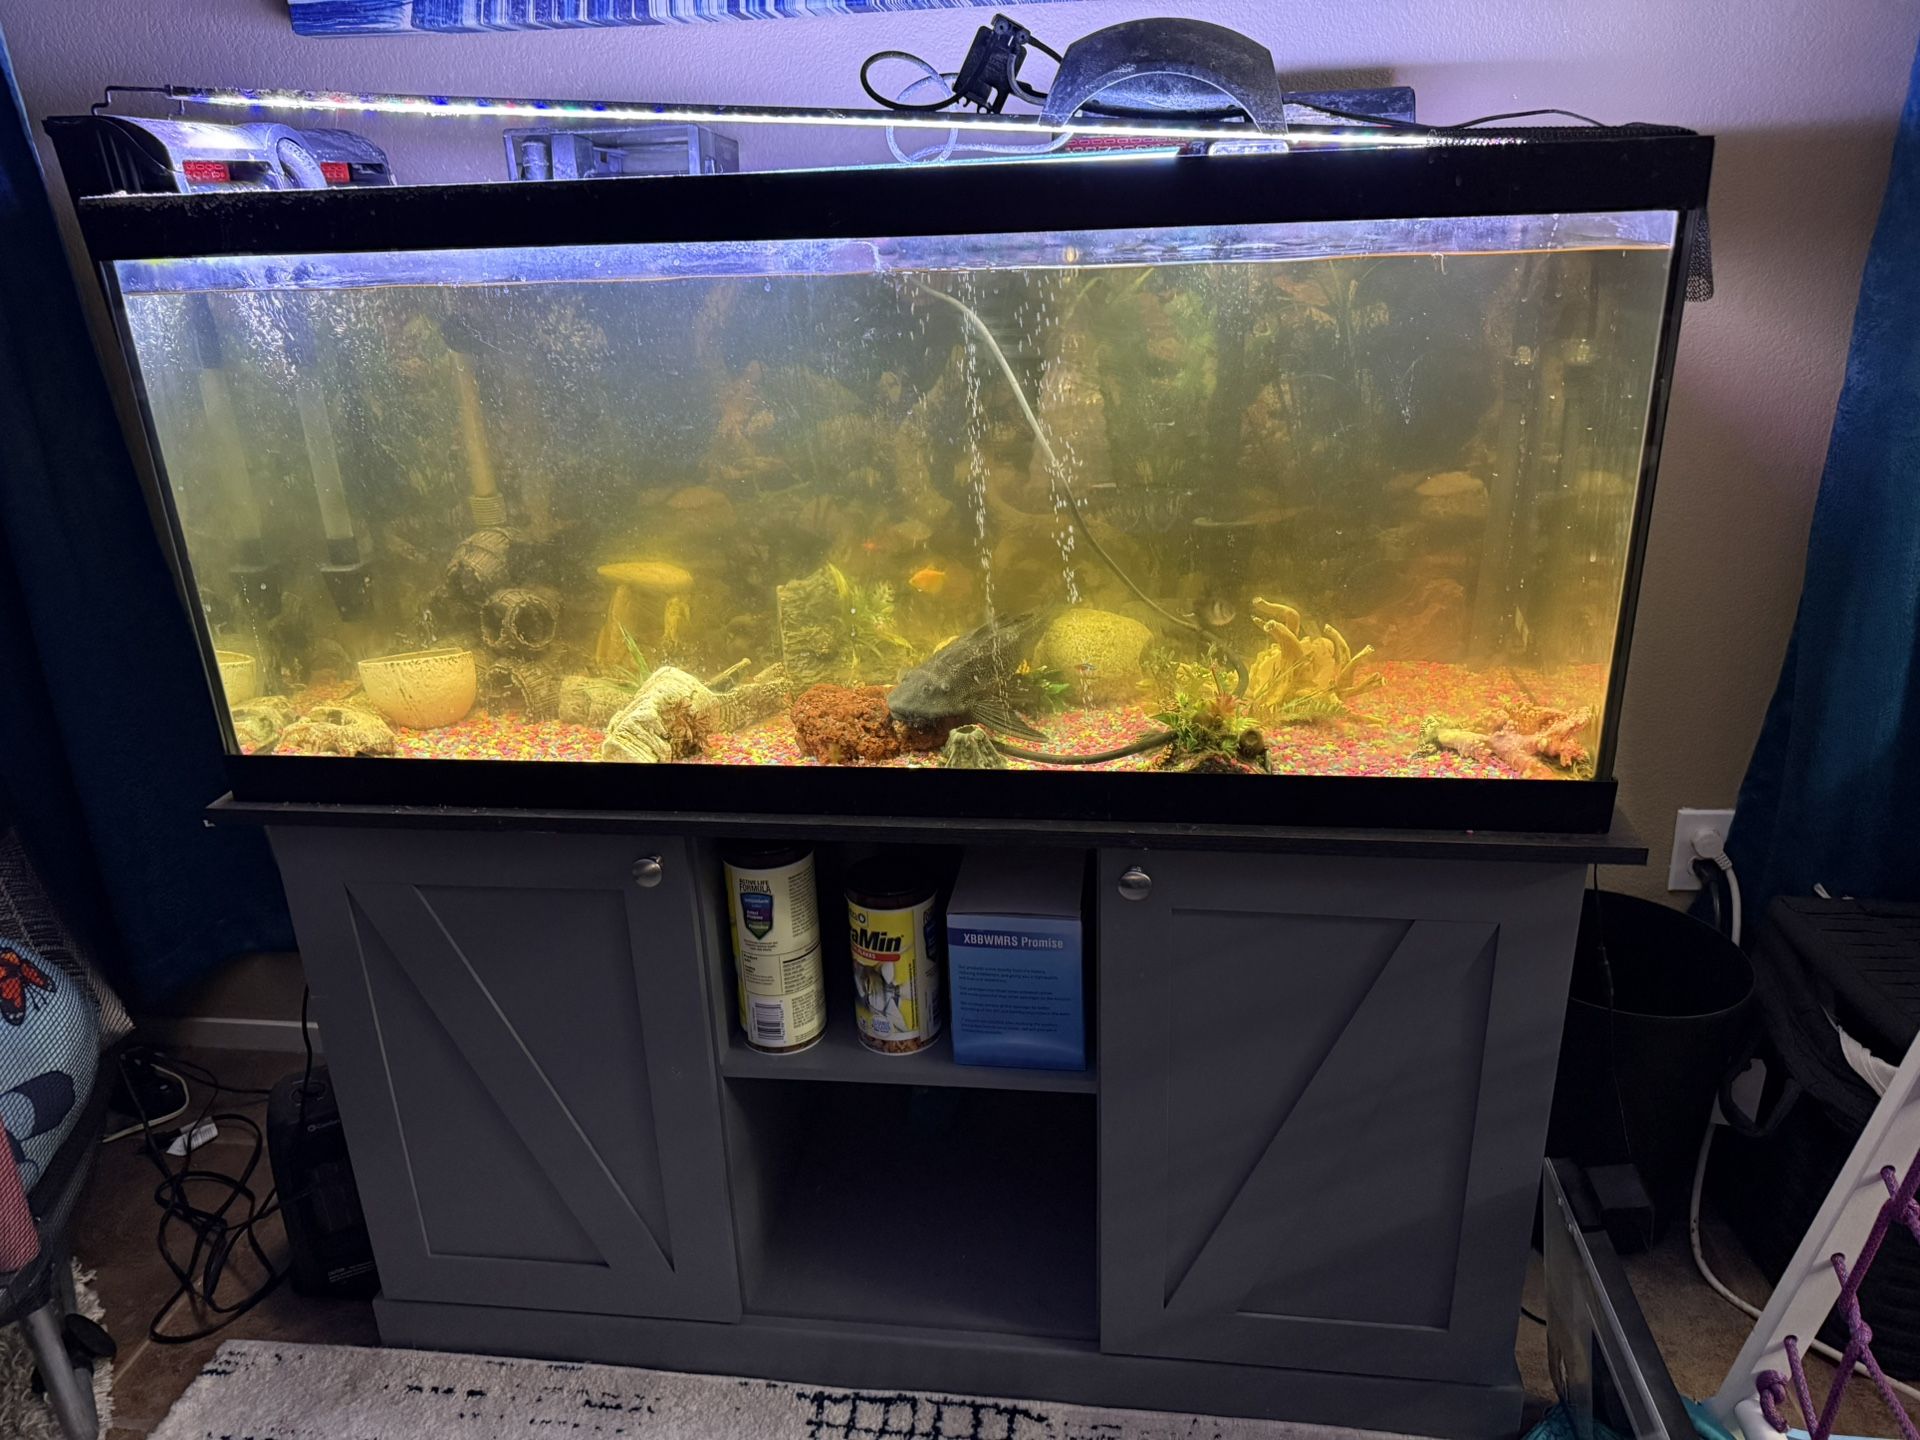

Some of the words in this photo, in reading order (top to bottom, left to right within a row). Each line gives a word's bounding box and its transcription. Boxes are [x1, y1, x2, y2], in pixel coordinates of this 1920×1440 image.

[739, 884, 771, 894] FORMULA
[850, 927, 902, 953] aMin
[963, 933, 1018, 947] XBBWMRS
[1020, 936, 1064, 949] Promise
